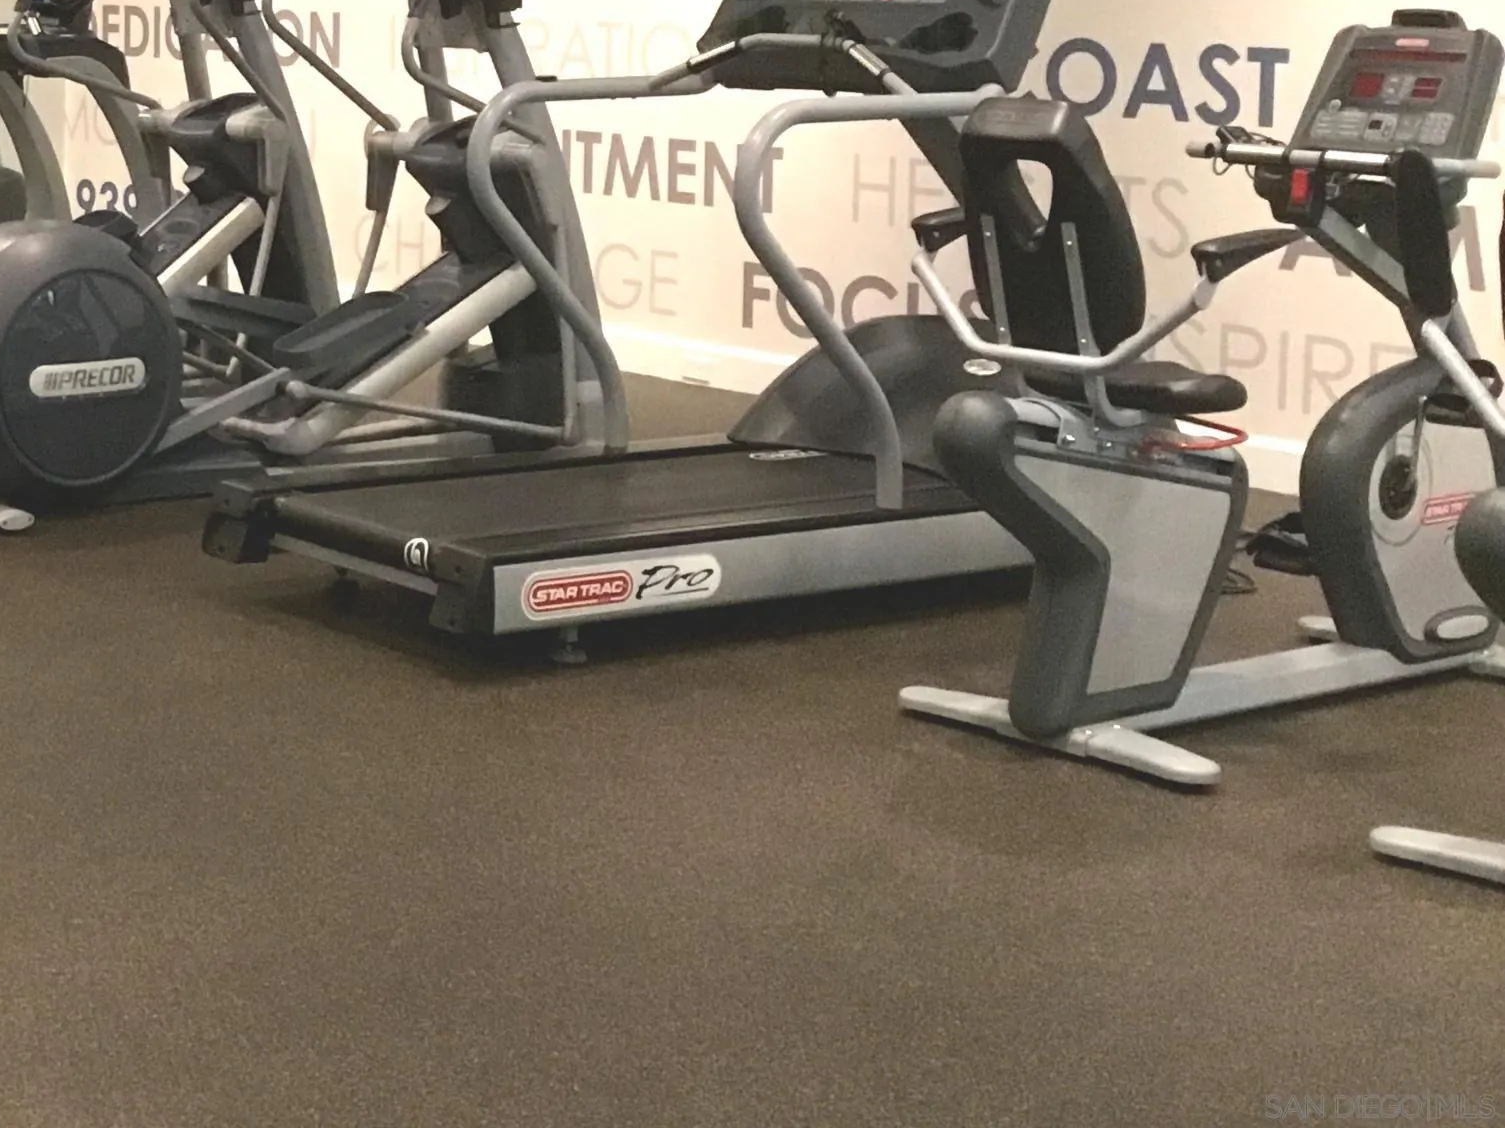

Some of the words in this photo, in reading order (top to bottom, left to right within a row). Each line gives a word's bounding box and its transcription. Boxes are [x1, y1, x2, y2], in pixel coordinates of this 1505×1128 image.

[1045, 37, 1291, 129] OAST
[57, 364, 136, 390] PRECOR
[535, 585, 578, 602] STAR
[579, 580, 626, 598] TRAC
[635, 564, 715, 600] Pro
